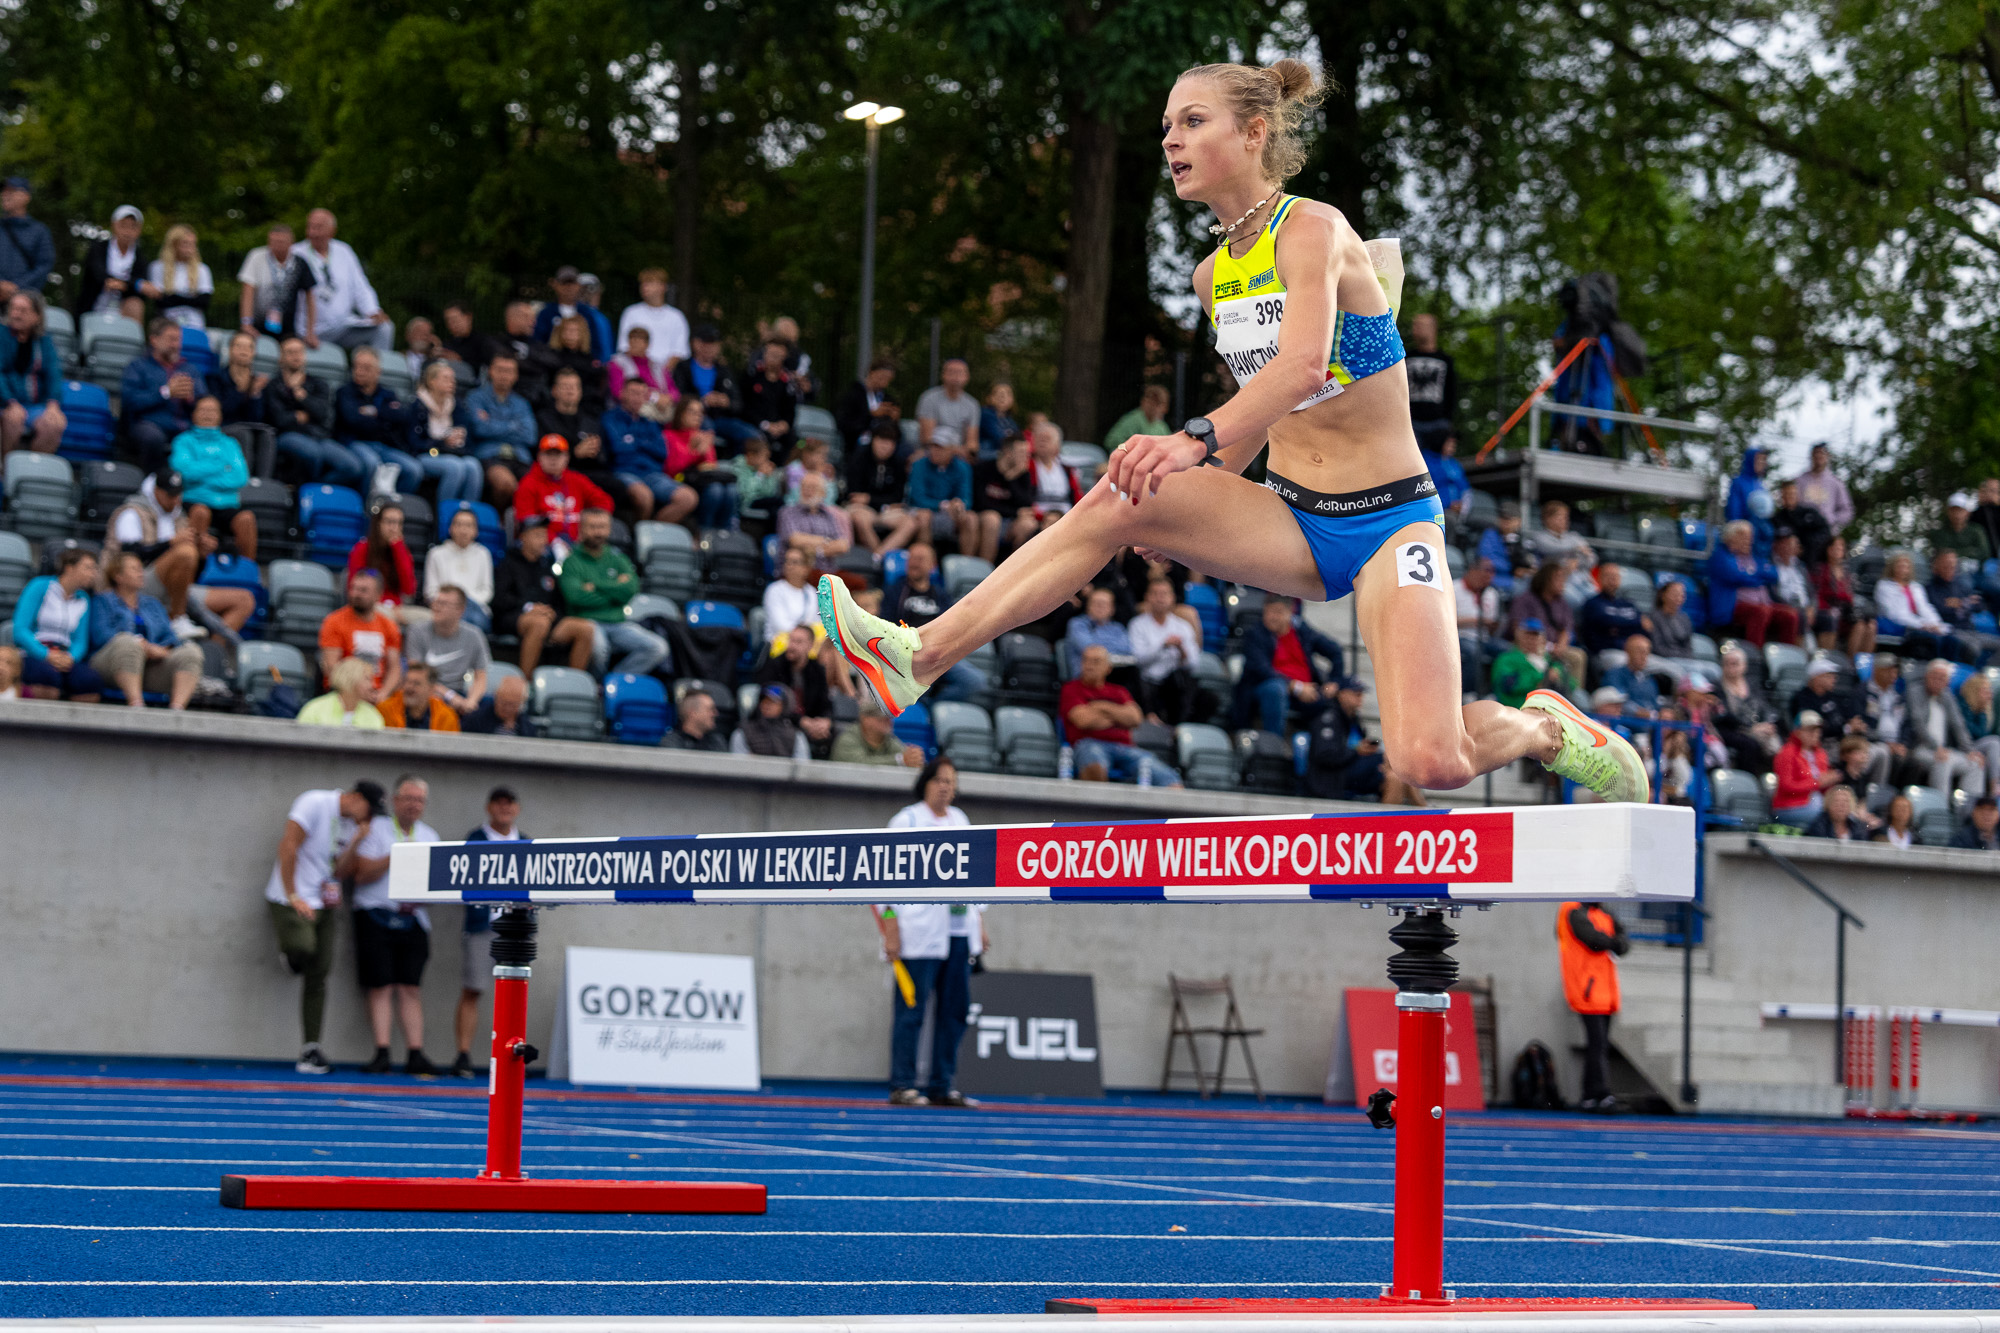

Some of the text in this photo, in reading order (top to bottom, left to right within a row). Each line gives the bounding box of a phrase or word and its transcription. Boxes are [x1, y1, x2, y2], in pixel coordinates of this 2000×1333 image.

[1255, 299, 1284, 326] 398
[1314, 493, 1393, 512] AdRunaLine
[1406, 544, 1434, 583] 3
[450, 827, 1478, 885] 99. PZLA MISTRZOSTWA POLSKI W LEKKIEJ ATLETYCE GORZÓW WIELKOPOLSKI 2023
[579, 979, 744, 1020] GORZÓW
